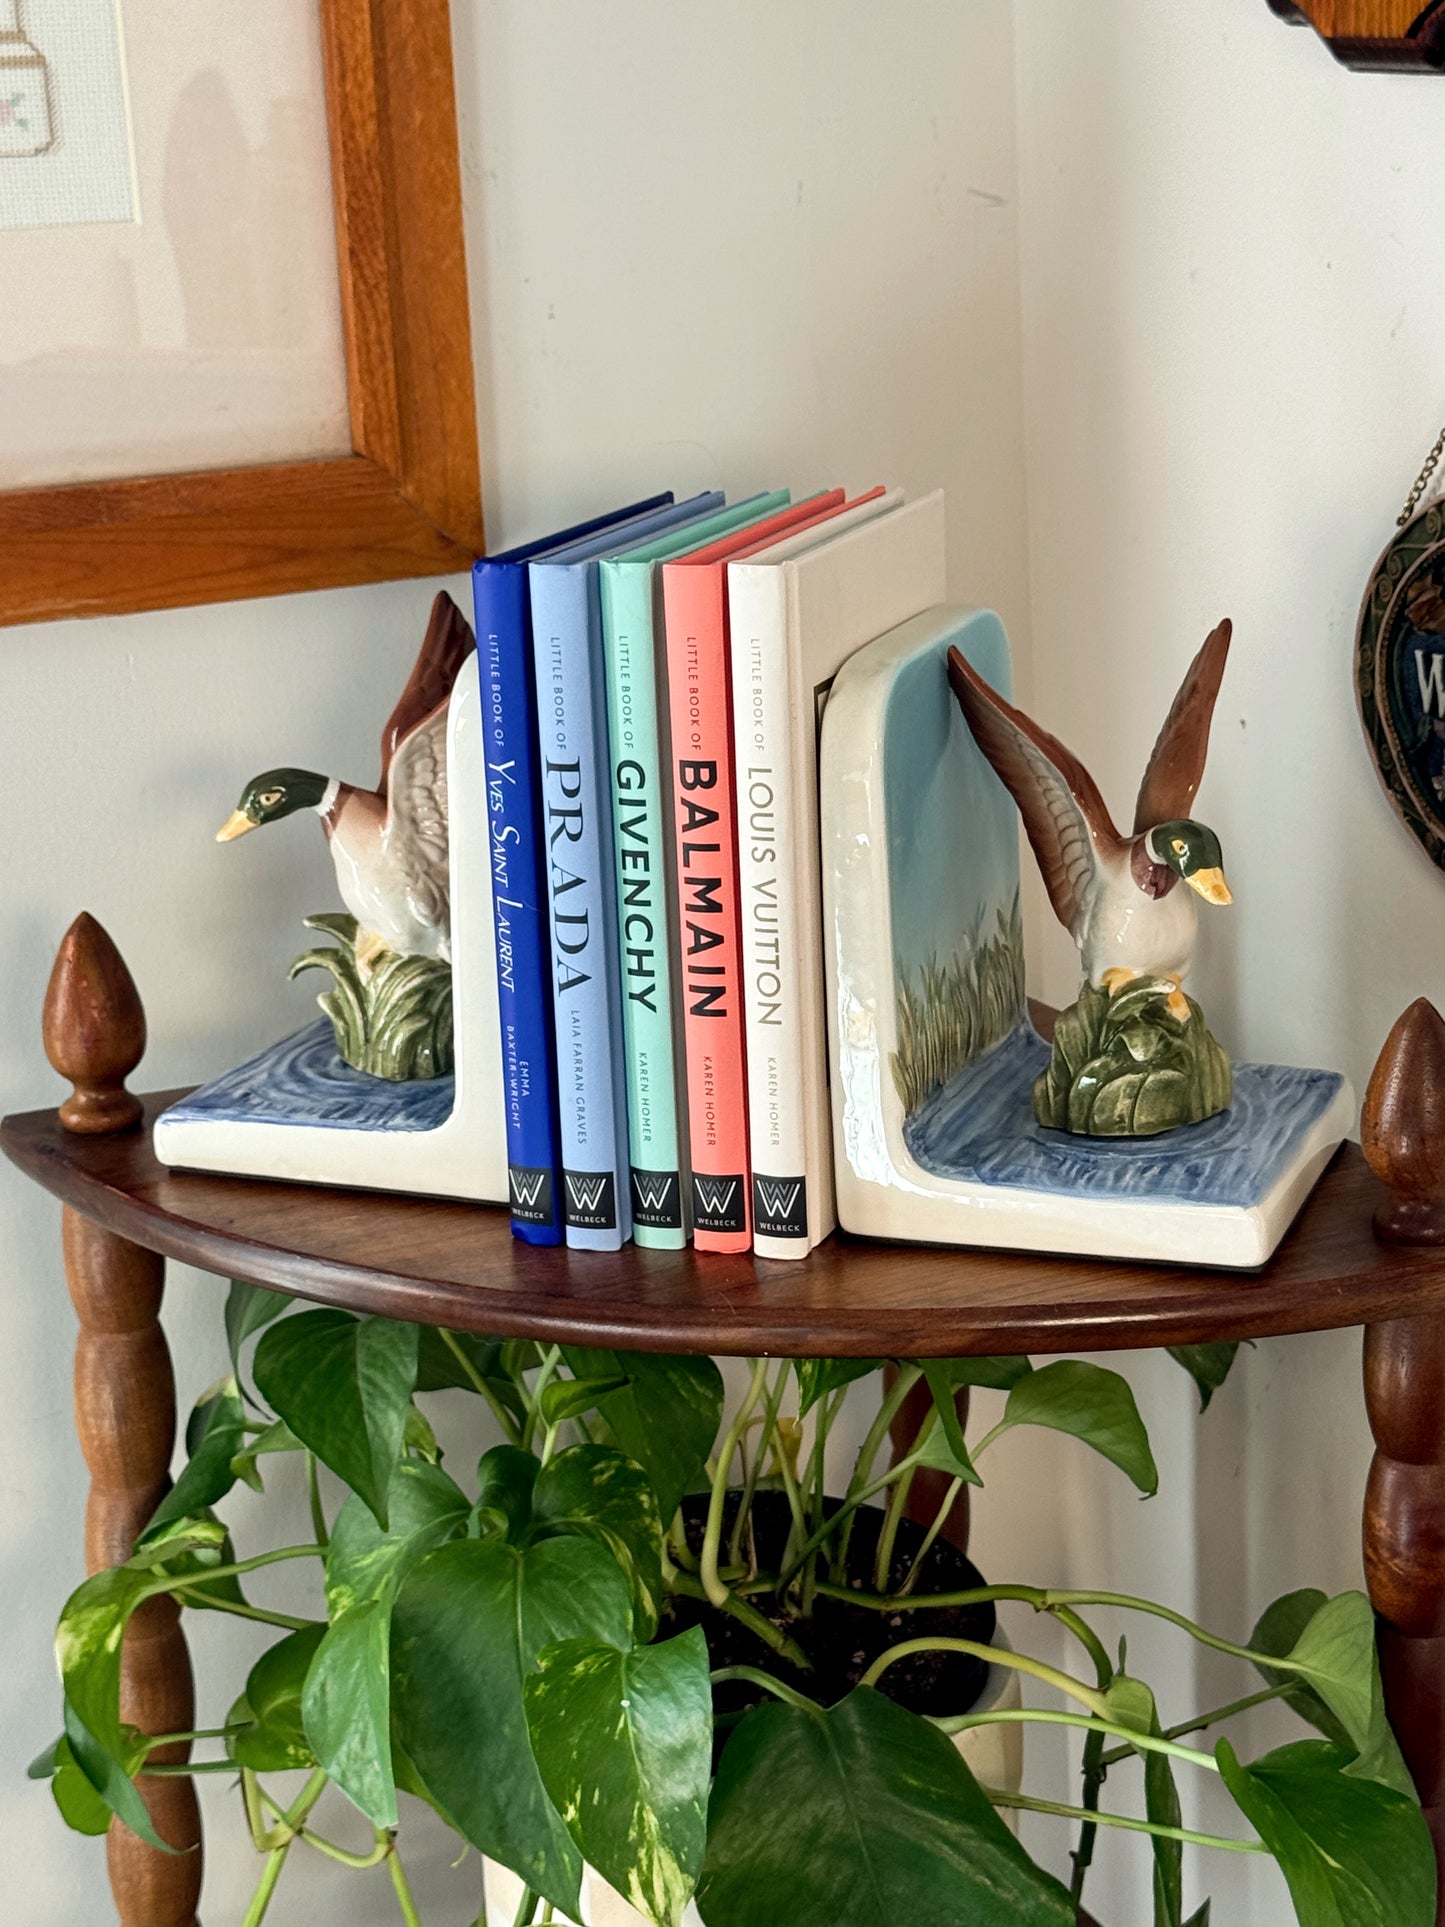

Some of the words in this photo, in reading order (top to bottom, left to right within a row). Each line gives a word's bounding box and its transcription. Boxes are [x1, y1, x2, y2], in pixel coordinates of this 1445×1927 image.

[488, 634, 499, 677] LITTLE
[550, 637, 562, 680] LITTLE
[618, 636, 630, 679] LITTLE
[686, 637, 698, 680] LITTLE
[750, 639, 761, 683] LITTLE
[490, 683, 504, 723] BOOK
[553, 685, 564, 726] BOOK
[621, 685, 632, 724] BOOK
[689, 686, 700, 726] BOOK
[752, 688, 763, 727] BOOK
[493, 729, 504, 747] OF
[555, 732, 566, 750] OF
[623, 731, 634, 748] OF
[691, 733, 702, 750] OF
[754, 734, 765, 751] OF
[749, 767, 776, 864] LOUIS
[545, 756, 592, 997] PRADA
[616, 760, 657, 1013] GIVENCHY
[679, 760, 728, 1017] BALMAIN
[752, 878, 782, 1026] VUITTON
[570, 1010, 580, 1037] LAIA
[519, 1061, 530, 1097] EMMA
[572, 1042, 583, 1091] FARRAN
[638, 1052, 649, 1092] KAREN
[702, 1056, 713, 1096] KAREN
[767, 1057, 778, 1097] KAREN
[576, 1097, 587, 1144] GRAVES
[641, 1098, 652, 1142] HOMER
[705, 1102, 716, 1146] HOMER
[768, 1102, 779, 1146] HOMER
[512, 1208, 544, 1219] WELBECK
[569, 1214, 606, 1223] WELBECK
[637, 1213, 672, 1222] WELBECK
[698, 1218, 736, 1226] WELBECK
[760, 1222, 800, 1232] WELBECK
